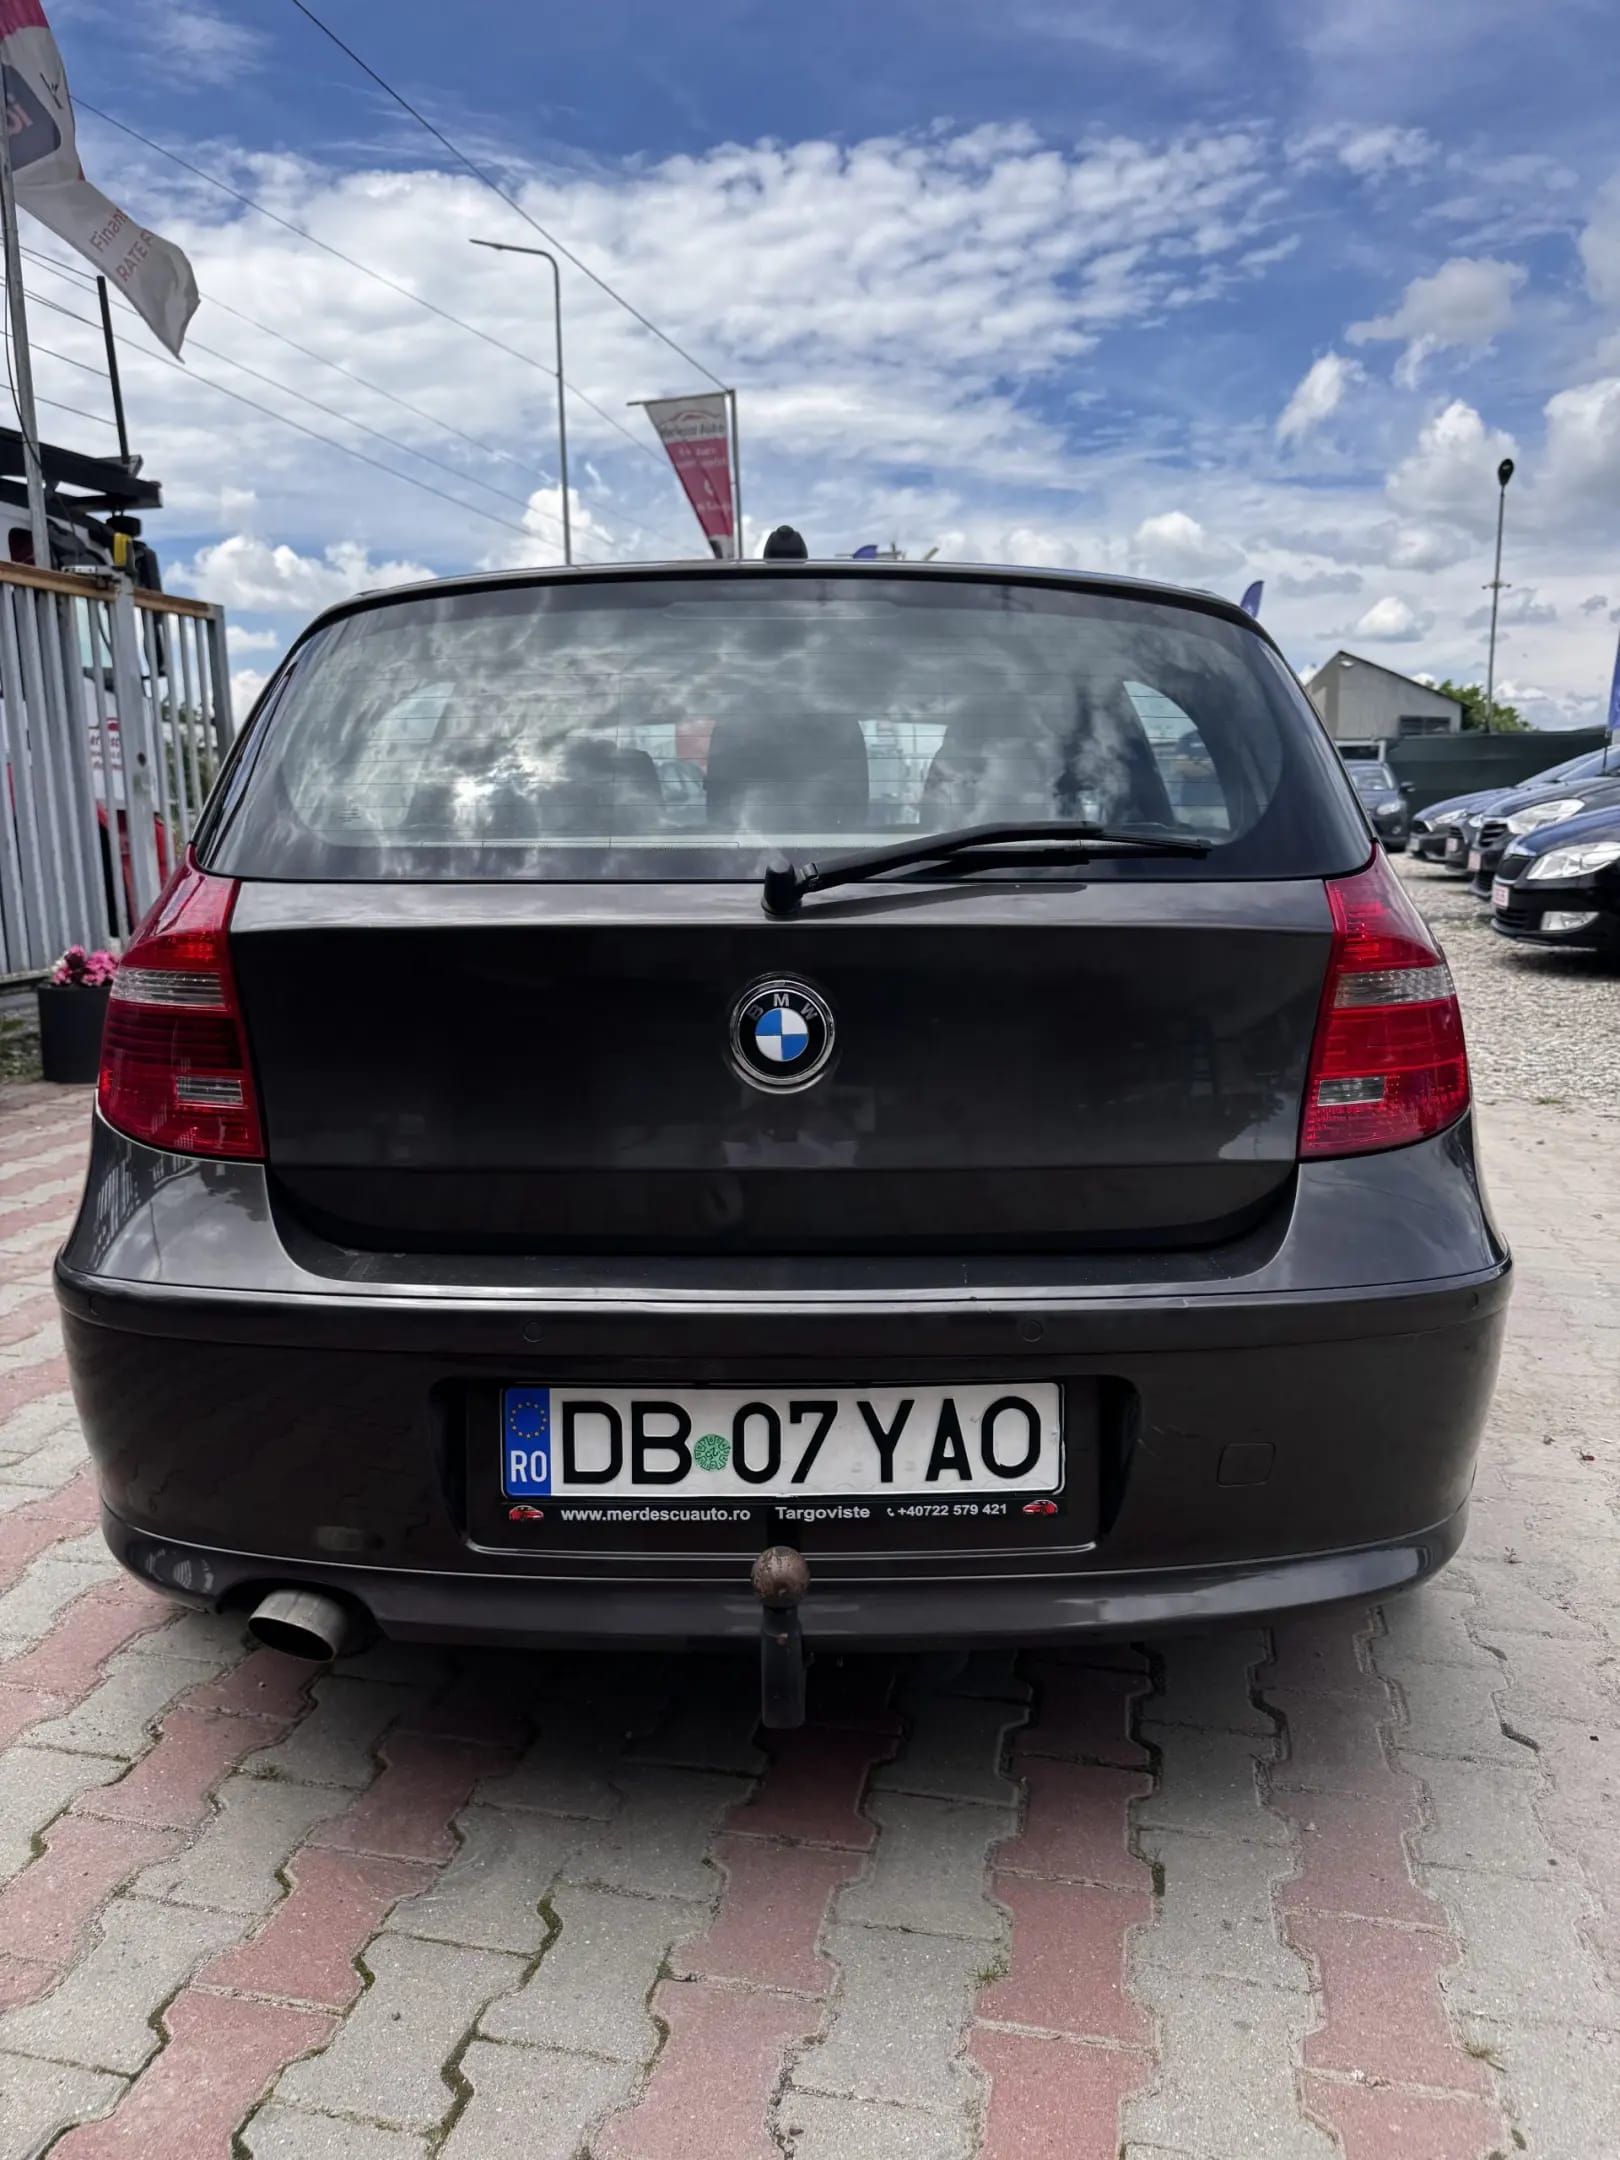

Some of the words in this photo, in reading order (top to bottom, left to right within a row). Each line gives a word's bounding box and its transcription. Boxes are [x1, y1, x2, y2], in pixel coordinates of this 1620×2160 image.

[89, 206, 128, 253] Finan
[115, 240, 148, 283] RATE
[745, 993, 818, 1020] BMW
[562, 1400, 692, 1484] DB
[732, 1400, 838, 1484] 07
[856, 1395, 1041, 1484] YAO
[510, 1450, 547, 1483] RO
[561, 1507, 750, 1521] www.merdescuauto.ro
[775, 1506, 871, 1522] Targoviste
[897, 1505, 949, 1517] +40722
[953, 1504, 979, 1515] 579
[982, 1503, 1007, 1515] 421
